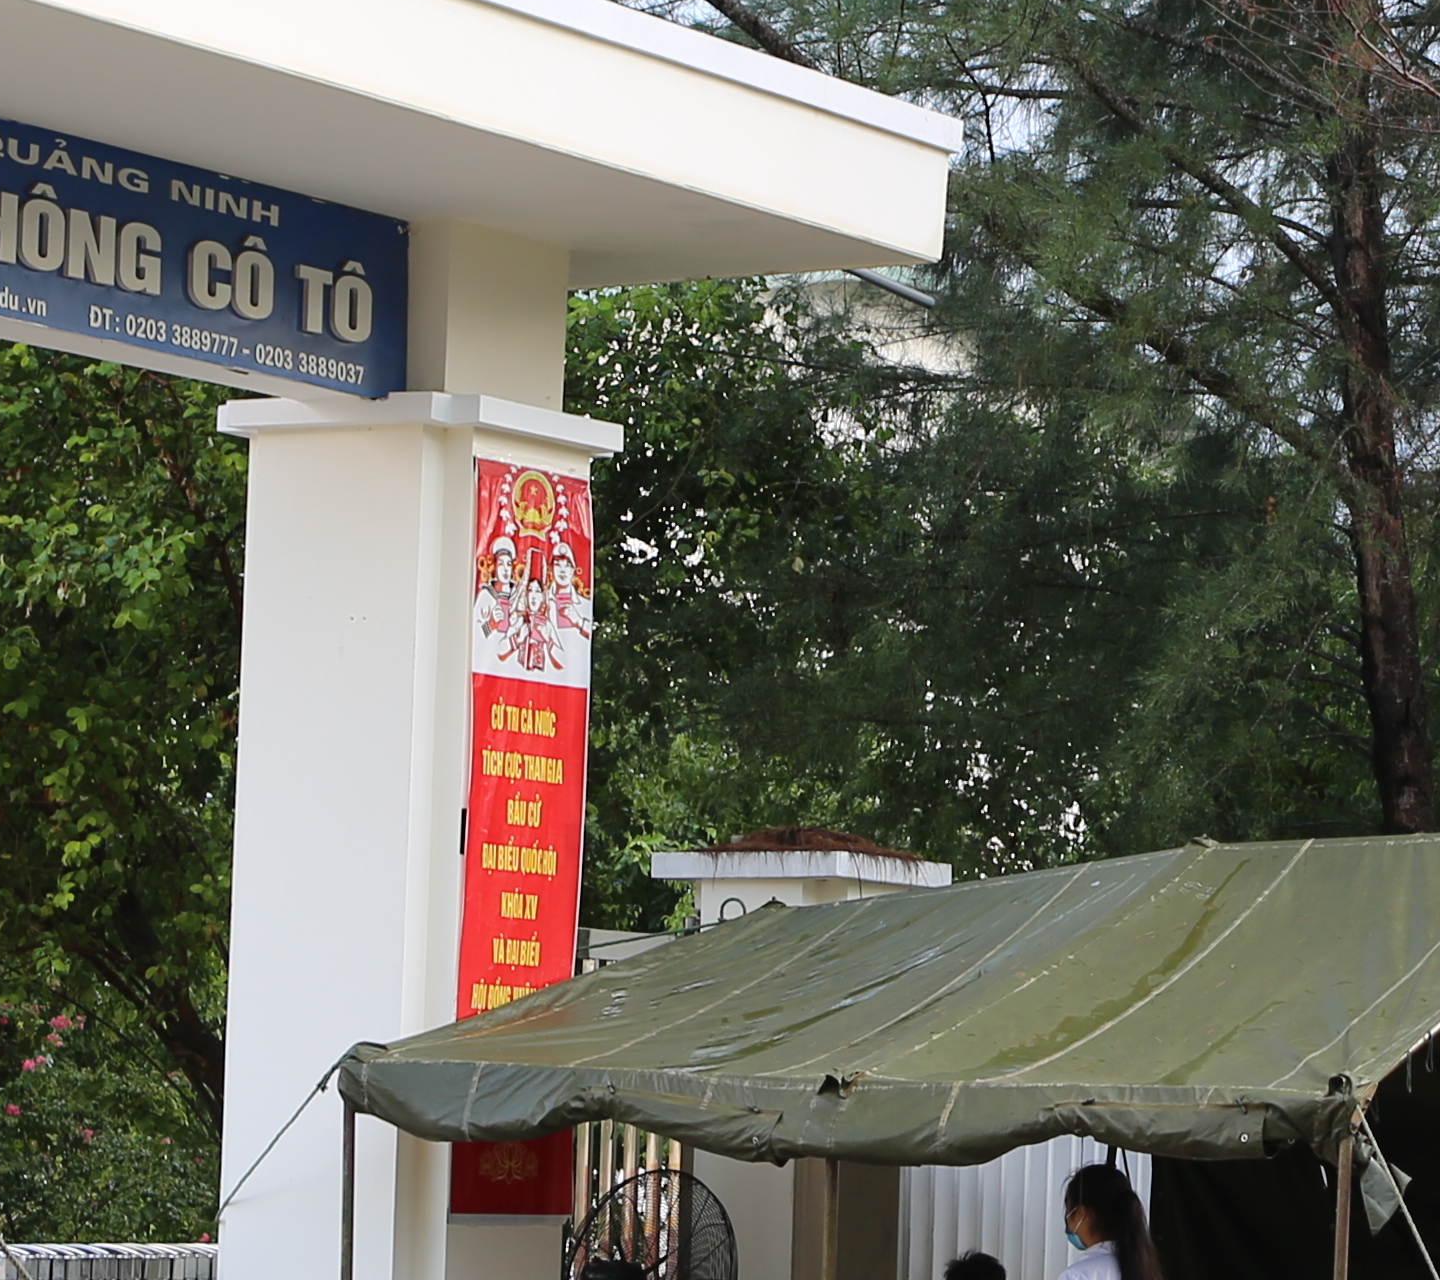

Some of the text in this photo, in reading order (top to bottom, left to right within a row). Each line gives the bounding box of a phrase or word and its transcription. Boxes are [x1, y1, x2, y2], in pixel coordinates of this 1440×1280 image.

[170, 176, 281, 228] NINH
[188, 235, 275, 321] CÔ
[294, 260, 373, 344] TÔ
[125, 314, 167, 343] 0203
[171, 323, 239, 359] 3889777
[255, 342, 293, 370] 0203
[298, 351, 365, 386] 3889037
[491, 696, 506, 730] CỬ
[521, 700, 533, 734] CẢ
[482, 745, 504, 776] TÍCH
[527, 793, 542, 828] CỬ
[482, 843, 497, 875] ĐẠI
[497, 835, 520, 872] BIỂU
[523, 894, 539, 920] XV
[492, 933, 506, 964] VÀ
